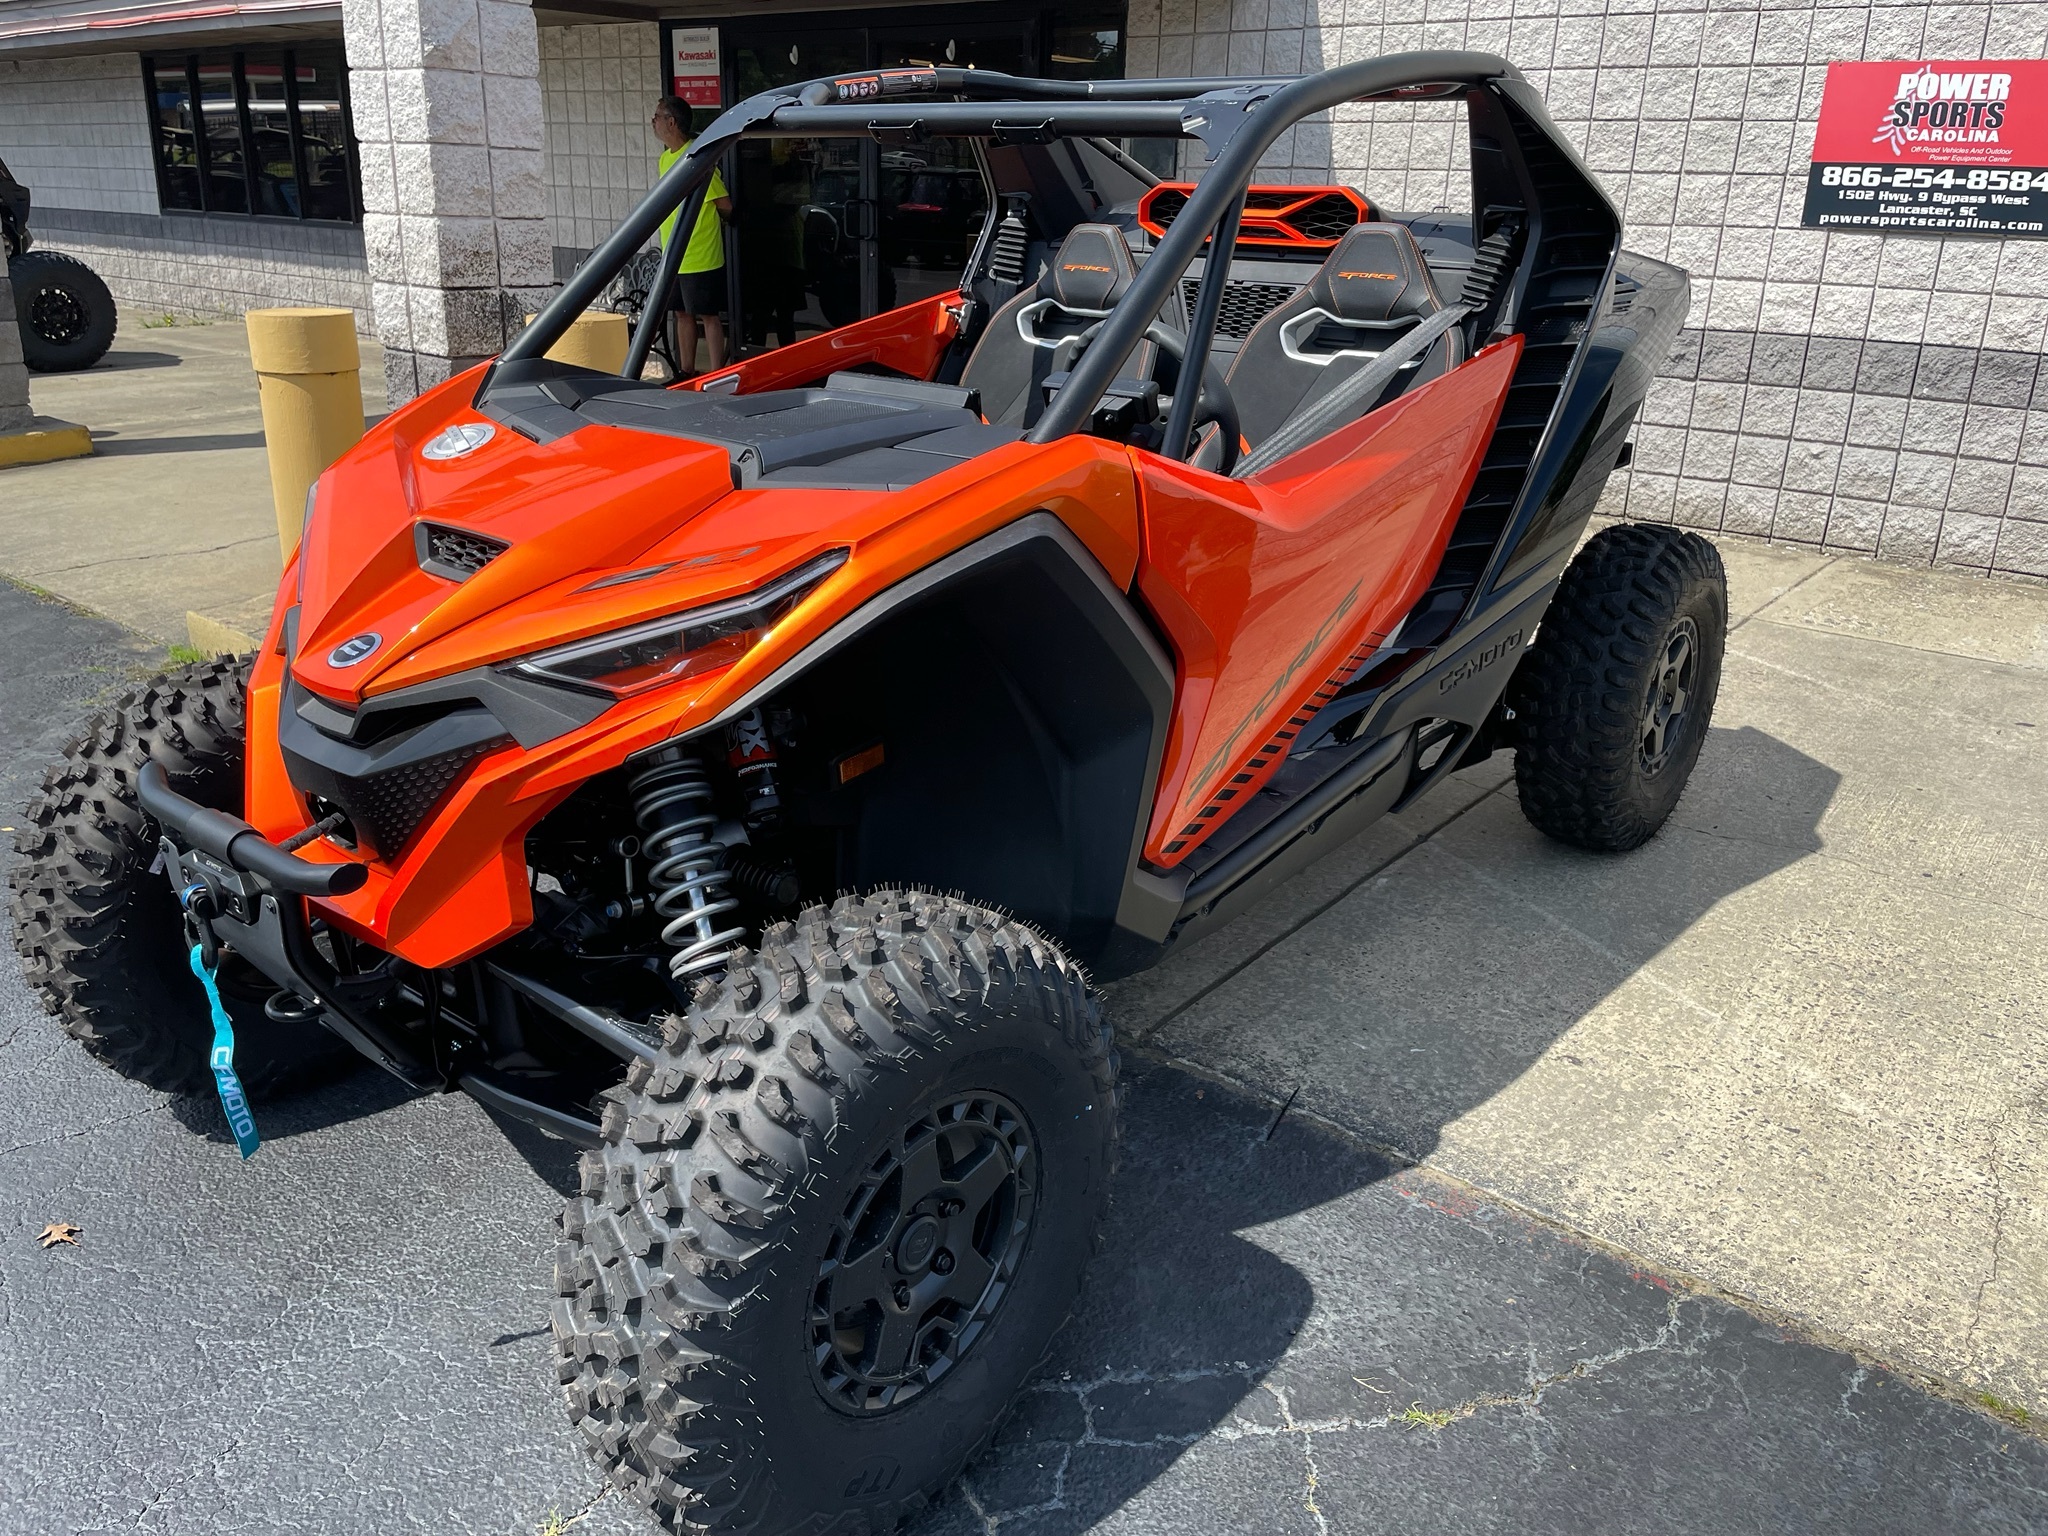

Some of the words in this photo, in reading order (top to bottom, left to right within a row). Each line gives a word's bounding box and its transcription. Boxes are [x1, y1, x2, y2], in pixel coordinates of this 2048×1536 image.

[678, 50, 717, 61] Kawasaki
[1896, 73, 2012, 100] POWER
[1892, 101, 2006, 128] SPORTS
[1906, 128, 2000, 142] CAROLINA
[1910, 145, 1941, 153] Off-Road
[1985, 147, 2013, 155] Outdoor
[1951, 154, 1987, 163] Equipment
[1821, 166, 2048, 192] 866-254-8584
[1838, 189, 1874, 200] 1502
[1878, 190, 1913, 203] Hwy.
[1918, 191, 1929, 201] 9
[1932, 192, 1987, 205] Bypass
[1991, 194, 2030, 206] West
[1879, 203, 1955, 217] Lancaster,
[1959, 206, 1978, 217] SC
[1819, 213, 2044, 231] powersportscarolina.com
[1440, 629, 1523, 695] CFMOTO
[738, 762, 778, 777] PERFORMANCE
[212, 1046, 254, 1138] CFMOTO
[844, 1463, 903, 1499] ITP
